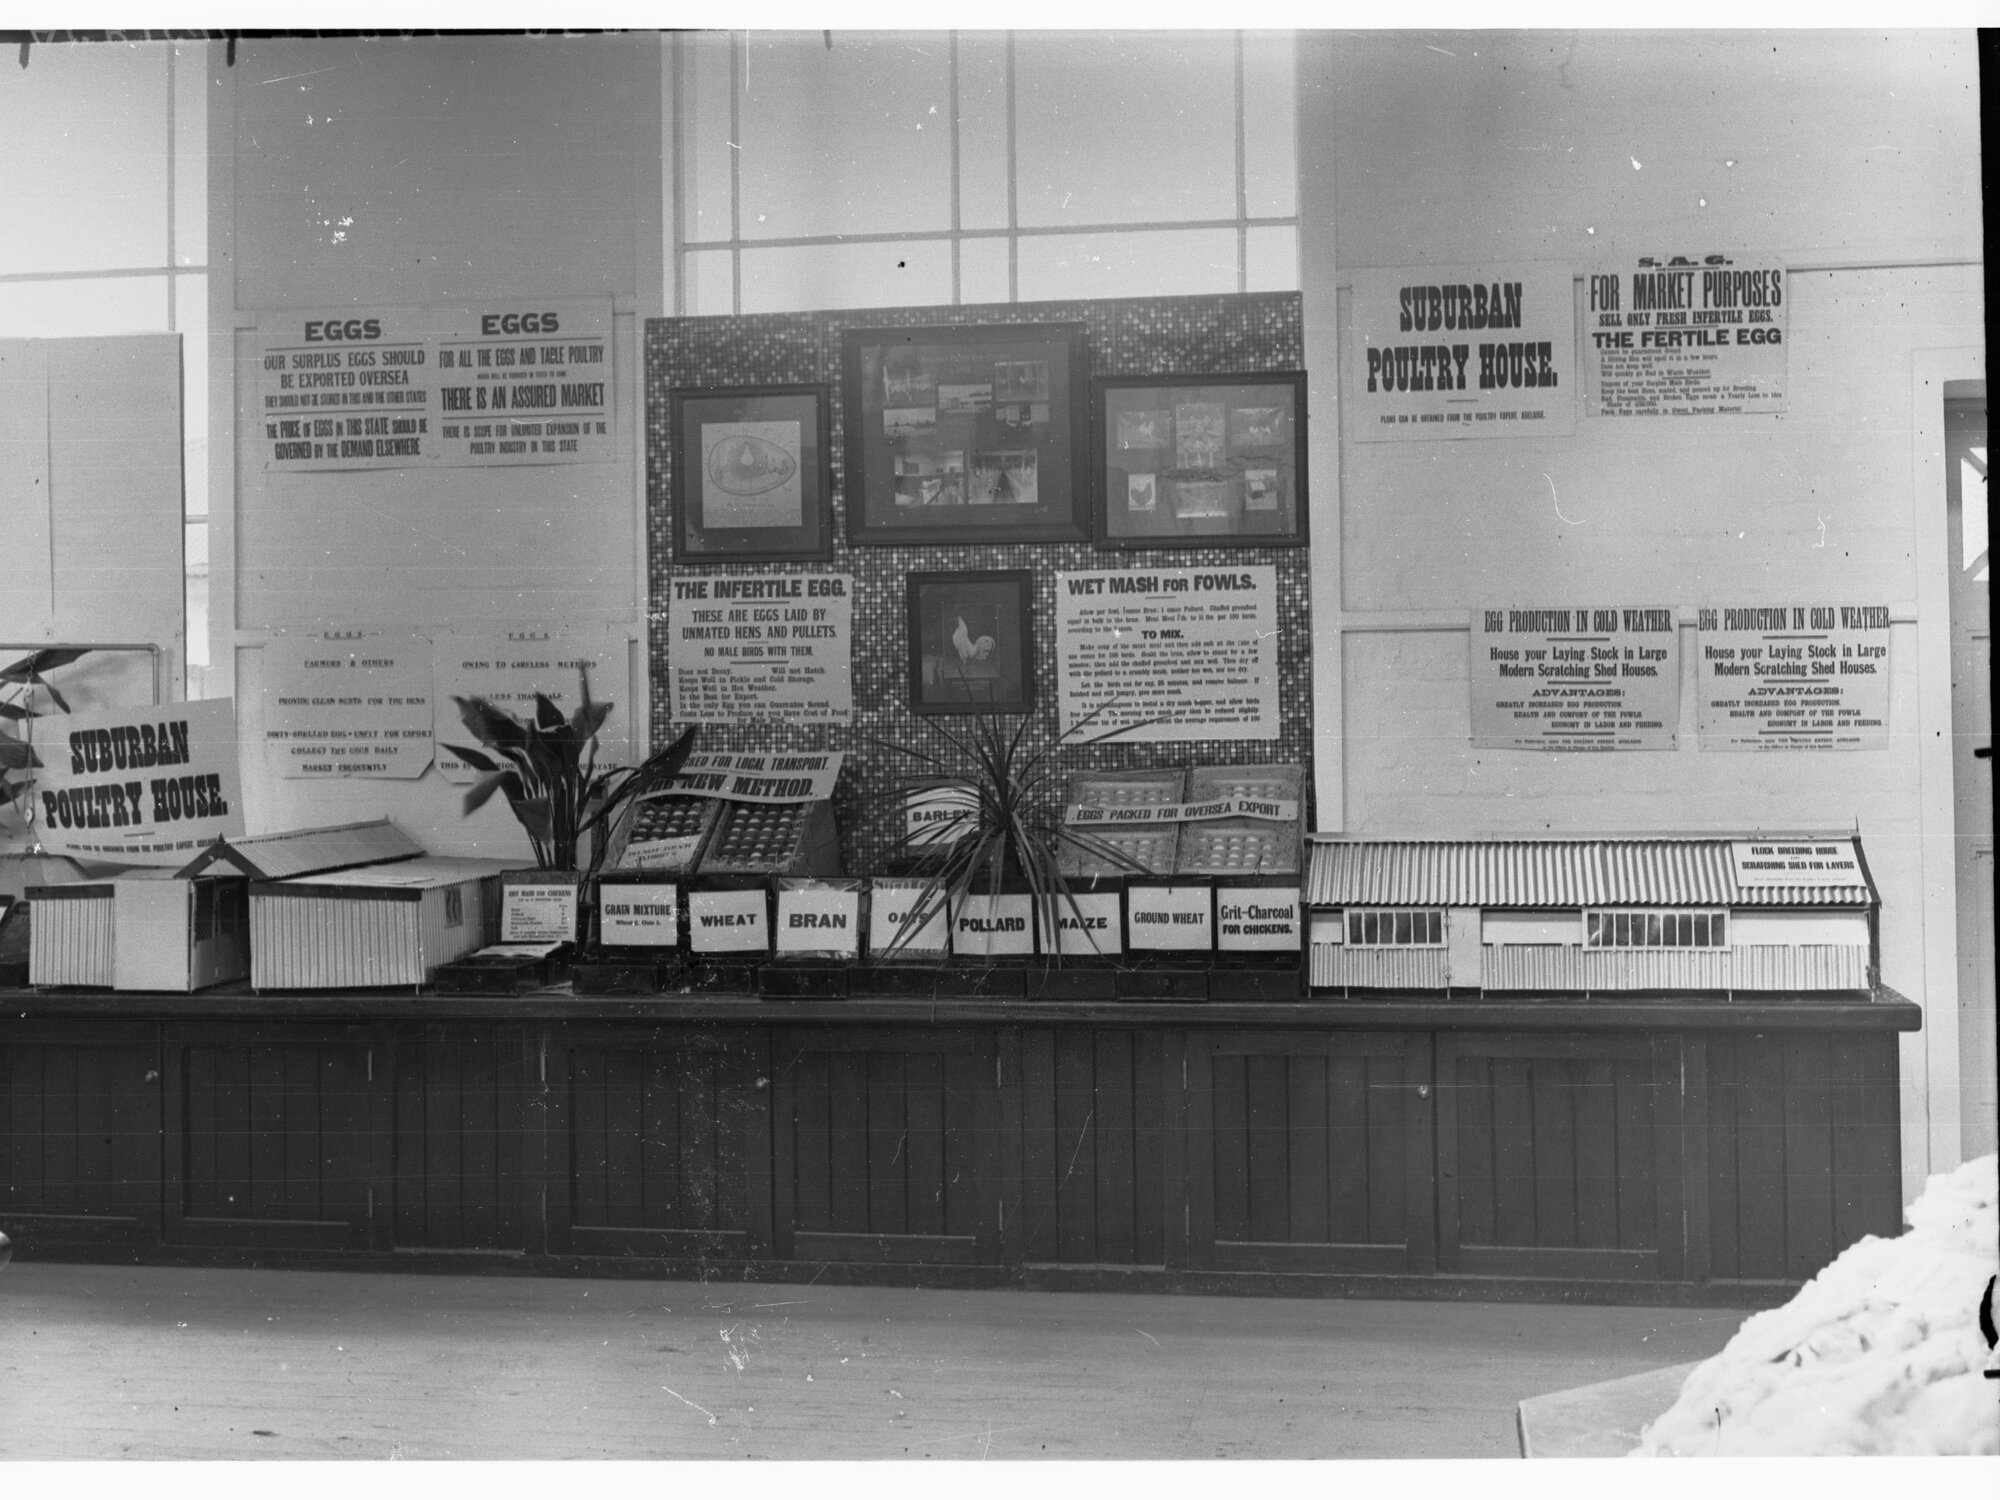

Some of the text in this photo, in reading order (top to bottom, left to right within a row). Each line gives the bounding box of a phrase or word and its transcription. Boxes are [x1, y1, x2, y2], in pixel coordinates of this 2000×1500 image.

[1591, 270, 1781, 312] FOR MARKET PURPOSES
[1400, 282, 1522, 332] SUBURBAN
[482, 313, 559, 335] EGGS
[1599, 310, 1773, 327] SELL ONLY FRESH INFERTILE EGGS.
[305, 320, 381, 341] EGGS
[1592, 328, 1781, 348] THE FERTILE EGG
[265, 350, 425, 370] OUR SURPLUS EGGS SHOULD
[439, 345, 603, 368] FOR ALL THE EGGS AND TABLE POULTRY
[1367, 341, 1557, 392] POULTRY HOUSE.
[281, 370, 409, 388] BE EXPORTED OVERSEA
[441, 383, 604, 411] THERE IS AN ASSURED MARKET
[267, 417, 427, 438] THE PRICE OF EGGS IN THIS STATE SHOULD BE
[275, 437, 420, 459] GOVERNED BY THE DEMAND ELSEWHERE
[675, 579, 846, 599] THE INFERTILE EGG.
[1068, 578, 1105, 595] WET
[1109, 577, 1158, 594] MASH
[1194, 574, 1256, 592] FOWLS.
[692, 608, 826, 622] THESE ARE EGGS LAID BY
[1485, 611, 1503, 633] EGG
[1509, 610, 1570, 632] PRODUCTION
[1576, 610, 1588, 632] IN
[1594, 610, 1617, 632] COLD
[1699, 607, 1890, 631] EGG PRODUCTION IN COLD WEATHER
[682, 625, 837, 639] UNMATED HENS AND PULLETS.
[1142, 629, 1184, 639] TO MIX.
[704, 646, 814, 657] NO MALE BIRDS WITH THEM.
[1490, 646, 1667, 662] House your Laying Stock in Large
[1705, 644, 1886, 660] House your Laying Stock in Large
[305, 660, 341, 668] FARMERS
[362, 659, 394, 667] OTHERS
[1500, 663, 1658, 678] Modern Scratching Shed Houses.
[1715, 661, 1877, 677] Modern Scratching Shed Houses.
[679, 685, 697, 693] Keeps
[1532, 689, 1625, 697] ADVANTAGES:
[1748, 687, 1843, 696] ADVANTAGES:
[69, 720, 189, 775] SUBURBAN
[711, 756, 732, 768] FOR
[736, 757, 765, 770] LOCAL
[770, 757, 829, 771] TRANSPORT.
[681, 773, 813, 797] NEW METHOD.
[42, 773, 228, 829] POULTRY HOUSE.
[913, 810, 971, 822] BARLEY
[1076, 801, 1280, 820] EGGS PACKED FOR OVERSEA EXPORT
[1751, 847, 1774, 855] FLOCK
[1742, 861, 1854, 870] SCRATCHING SHED FOR LAYERS
[605, 904, 671, 915] GRAIN MIXTURE
[701, 914, 757, 927] WHEAT
[789, 913, 846, 928] BRAN
[959, 917, 1025, 932] POLLARD
[1134, 912, 1204, 925] GROUND WHEAT
[1222, 924, 1292, 935] FOR CHICKENS.
